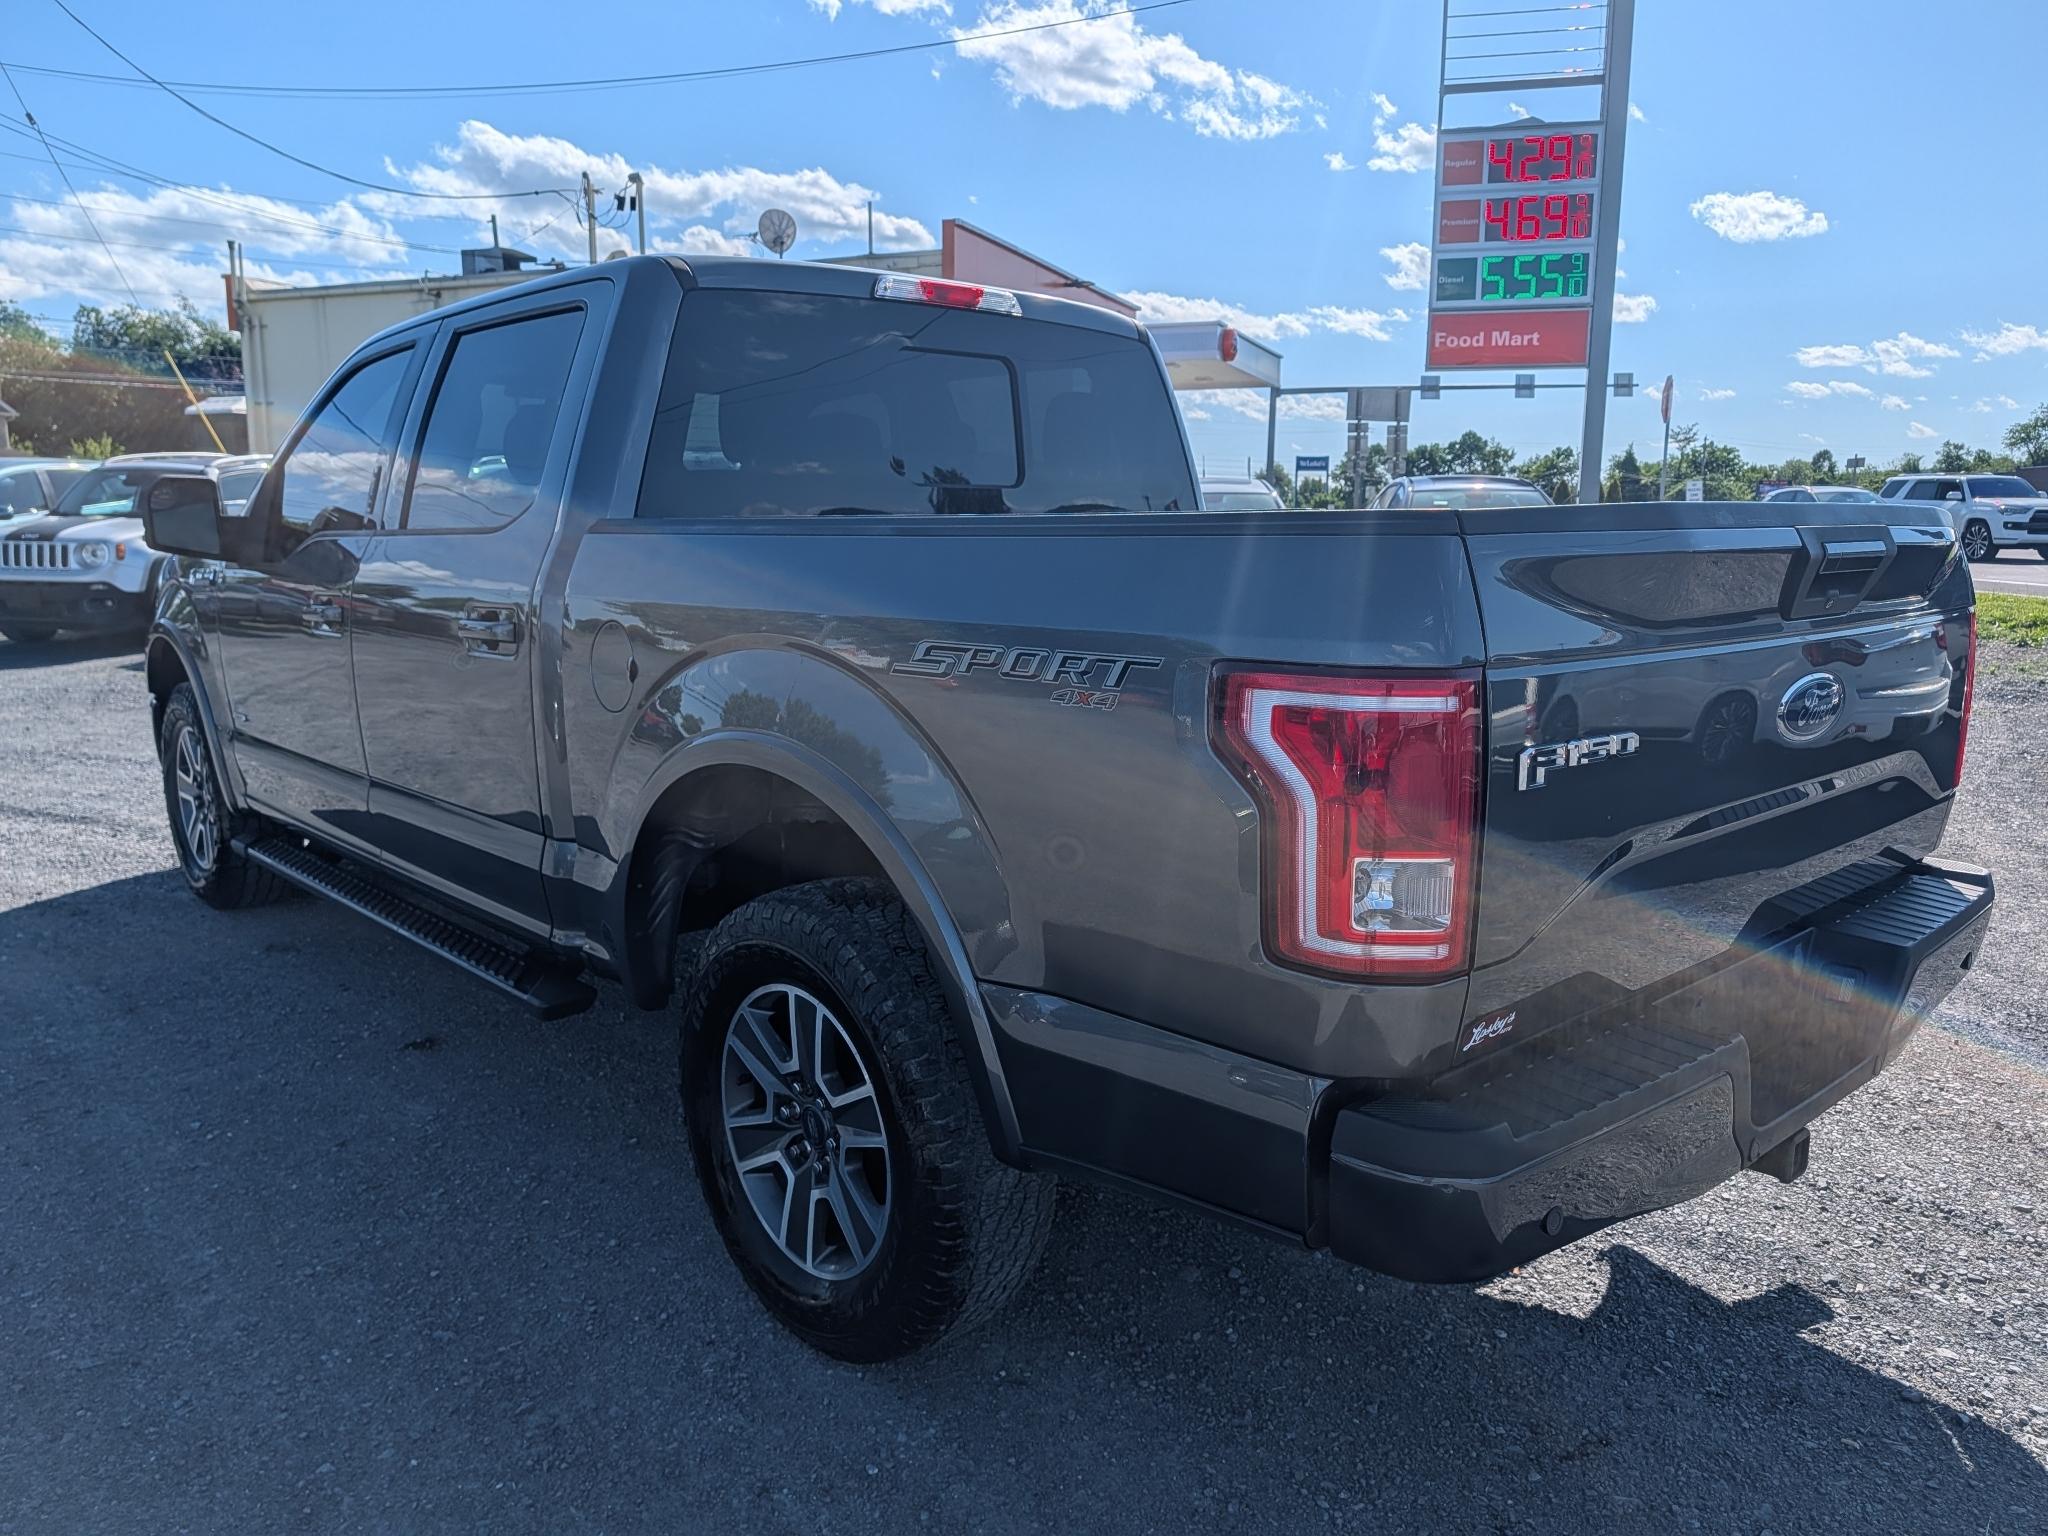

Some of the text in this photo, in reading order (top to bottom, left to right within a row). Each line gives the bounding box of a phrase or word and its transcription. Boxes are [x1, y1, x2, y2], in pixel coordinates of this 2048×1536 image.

[1444, 159, 1476, 168] Regular
[1438, 275, 1464, 284] Diesel
[1434, 330, 1540, 348] Food Mart
[890, 639, 1166, 690] SPORT
